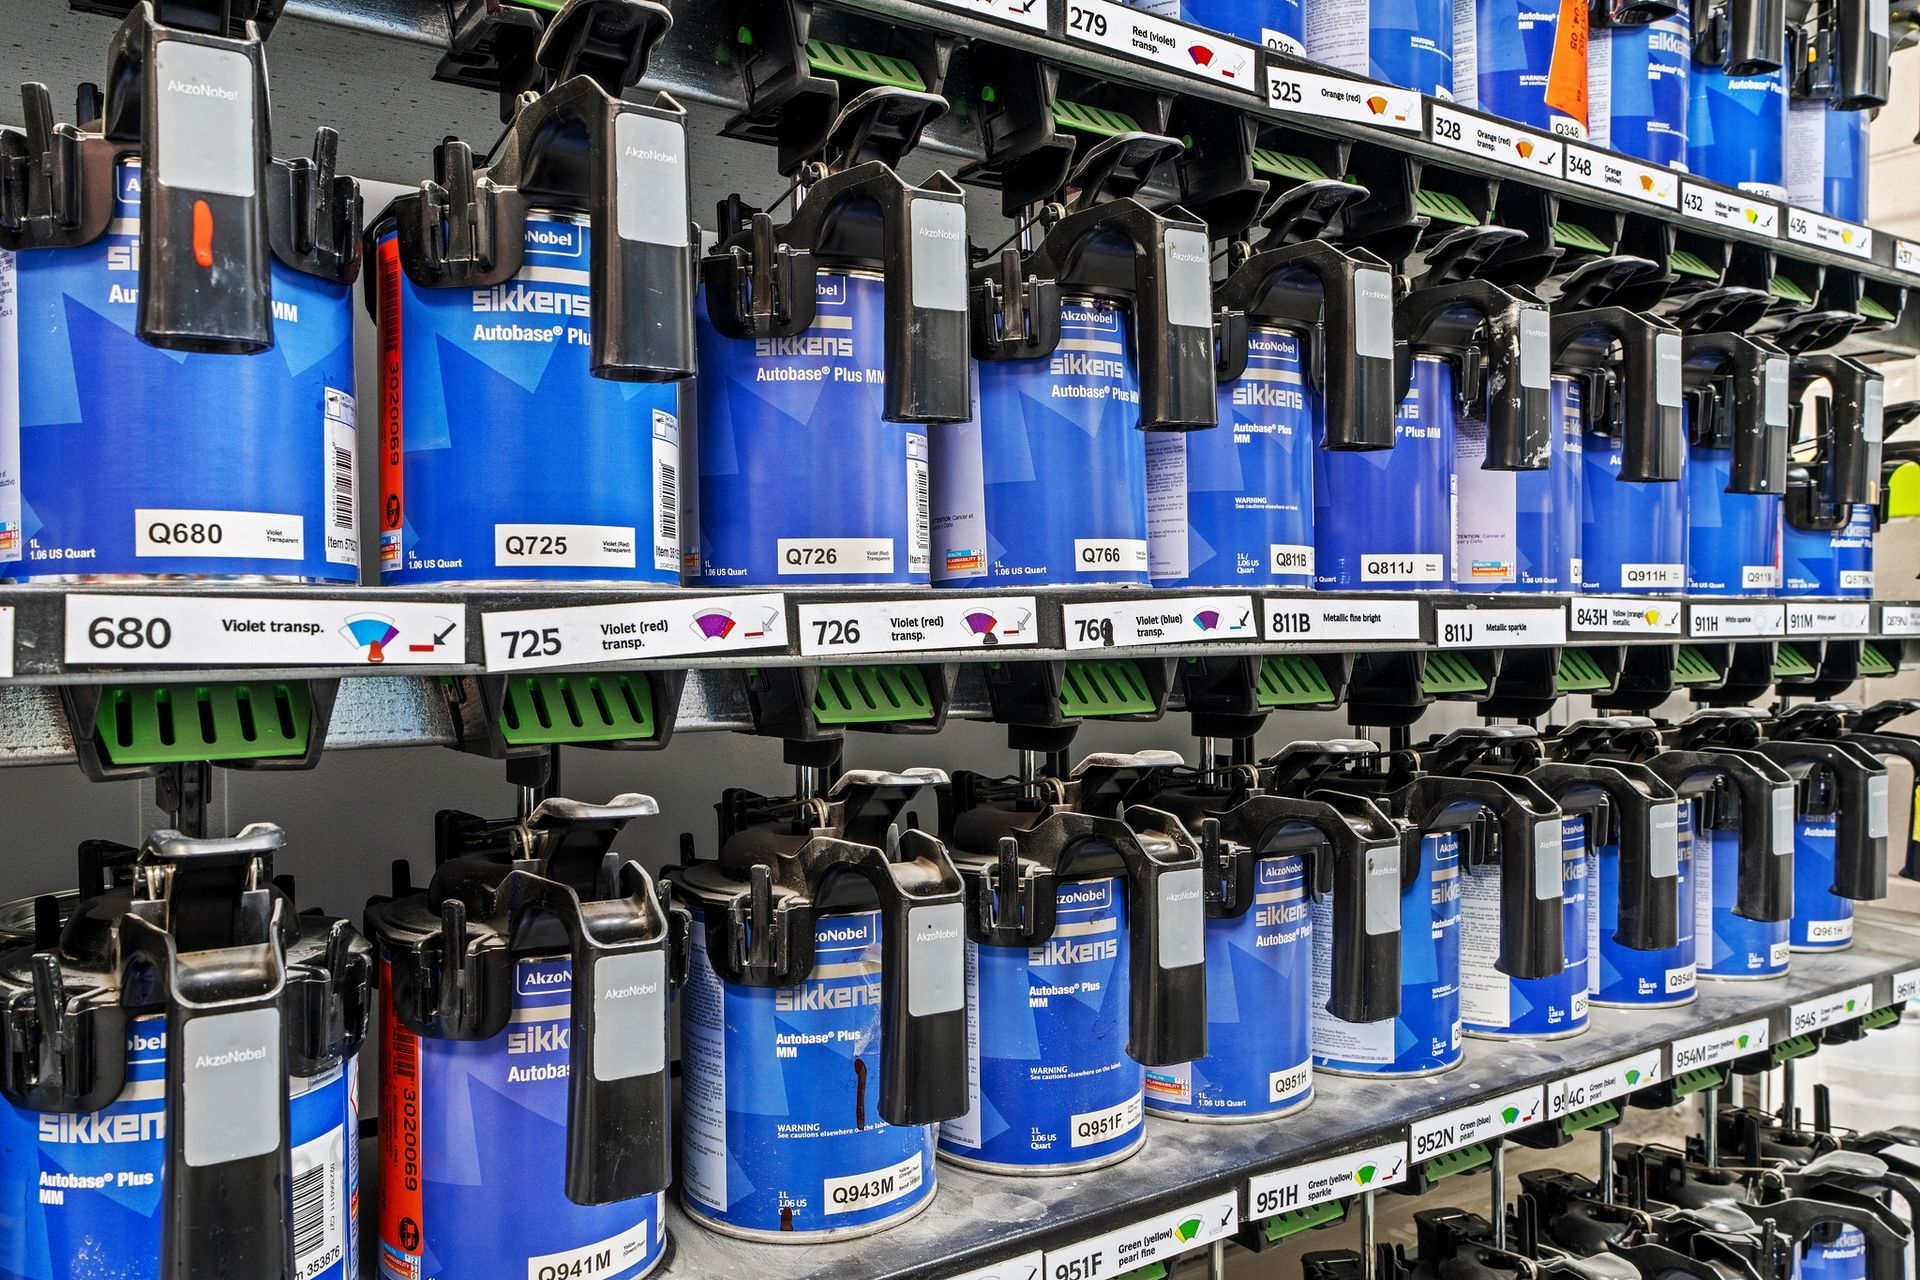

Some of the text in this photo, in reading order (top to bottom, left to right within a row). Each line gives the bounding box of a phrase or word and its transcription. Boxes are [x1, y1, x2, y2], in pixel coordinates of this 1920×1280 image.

[1070, 7, 1107, 37] 279
[1518, 21, 1534, 30] MM
[1132, 26, 1176, 49] Red (violet)
[1132, 38, 1160, 54] transp.
[167, 79, 239, 101] AkzoNobel
[1270, 80, 1302, 104] 325
[1321, 87, 1361, 105] Orange (red)
[1435, 116, 1461, 141] 328
[1555, 122, 1579, 139] Q348
[1477, 128, 1511, 148] Orange (red)
[1477, 138, 1496, 152] transp.
[625, 146, 677, 165] AkzoNobel
[1568, 155, 1592, 176] 348
[1604, 165, 1622, 177] Orange
[1604, 174, 1622, 186] (yellow)
[1684, 193, 1703, 212] 432
[1790, 217, 1807, 235] 436
[919, 227, 960, 242] AkzoNobel
[1172, 252, 1207, 264] AkzoNobel
[472, 284, 590, 318] sikkens
[1061, 310, 1113, 325] AkzoNobel
[755, 337, 853, 358] sikkens
[1050, 354, 1123, 379] sikkens
[1232, 383, 1302, 410] sikkens
[389, 361, 399, 467] 3020069
[1234, 434, 1250, 443] MM
[1405, 425, 1441, 439] Plus MM
[1235, 497, 1267, 505] WARNING
[149, 522, 223, 545] Q680
[29, 539, 40, 549] 1L
[505, 535, 568, 557] Q725
[30, 548, 96, 561] 1.06 US Quart
[408, 551, 417, 560] 1L
[786, 548, 838, 566] Q726
[1082, 548, 1121, 564] Q766
[1276, 552, 1307, 568] Q811B
[408, 558, 463, 570] 1.06 US Quart
[994, 560, 1003, 568] 1L
[995, 565, 1047, 576] 1.06 US Quart
[1237, 559, 1259, 567] 1.06 US
[1237, 566, 1255, 574] Quart
[1368, 561, 1414, 575] Q811J
[704, 567, 747, 577] 1.06 US Quart
[1319, 576, 1337, 584] Quart
[1627, 569, 1667, 582] Q911H
[890, 616, 944, 629] Violet (red)
[1136, 613, 1183, 627] Violet (blue)
[1323, 613, 1381, 624] Metallic fine bright
[1577, 609, 1608, 626] 843H
[1612, 610, 1645, 619] Yellow (orange)
[1790, 614, 1813, 629] 911M
[222, 618, 325, 636] Violet transp.
[601, 620, 669, 636] Violet (red)
[1273, 613, 1311, 634] 811B
[1486, 623, 1527, 633] Metallic sparkle
[1695, 616, 1718, 632] 911H
[88, 617, 172, 650] 680
[812, 619, 861, 646] 726
[891, 630, 926, 643] transp.
[1136, 627, 1165, 640] transp.
[1445, 623, 1473, 643] 811J
[500, 628, 562, 659] 725
[602, 637, 646, 651] transp.
[916, 928, 958, 943] AkzoNobel
[1813, 926, 1843, 936] Q961H
[1028, 938, 1117, 967] sikkens
[605, 982, 657, 1000] AkzoNobel
[1029, 982, 1100, 996] Autobase® Plus
[1029, 998, 1048, 1008] MM
[1795, 1011, 1816, 1031] 954S
[776, 1030, 861, 1045] Autobase® Plus
[195, 1047, 266, 1069] AkzoNobel
[776, 1047, 797, 1058] MM
[1677, 1046, 1706, 1068] 954M
[1030, 1066, 1067, 1075] WARNING
[1041, 1073, 1067, 1081] cautions
[1067, 1070, 1096, 1079] elsewhere
[1275, 1070, 1307, 1094] Q951H
[1590, 1076, 1617, 1092] Green (blue)
[1198, 1099, 1247, 1107] 1.06 US Quart
[1553, 1087, 1585, 1113] 94G
[777, 1123, 820, 1132] WARNING
[1078, 1112, 1122, 1138] Q951F
[1460, 1114, 1491, 1132] Green (blue)
[403, 1088, 418, 1192] 3020069
[1031, 1134, 1046, 1142] 1.06
[1417, 1126, 1455, 1155] 952N
[1459, 1129, 1475, 1142] pearl
[1031, 1142, 1051, 1150] Quart
[39, 1171, 154, 1189] Autobase® Plus
[1308, 1170, 1353, 1190] Green (yellow)
[40, 1188, 64, 1205] MM
[778, 1191, 789, 1200] 1L
[832, 1174, 895, 1205] Q943M
[1308, 1187, 1332, 1201] sparkle
[778, 1199, 807, 1208] 1.06 US
[1256, 1184, 1298, 1214] 951H
[1118, 1228, 1173, 1255] Green (yellow)
[306, 1245, 340, 1277] 353876
[1118, 1246, 1156, 1268] pearl fine
[1055, 1252, 1102, 1280] 951F
